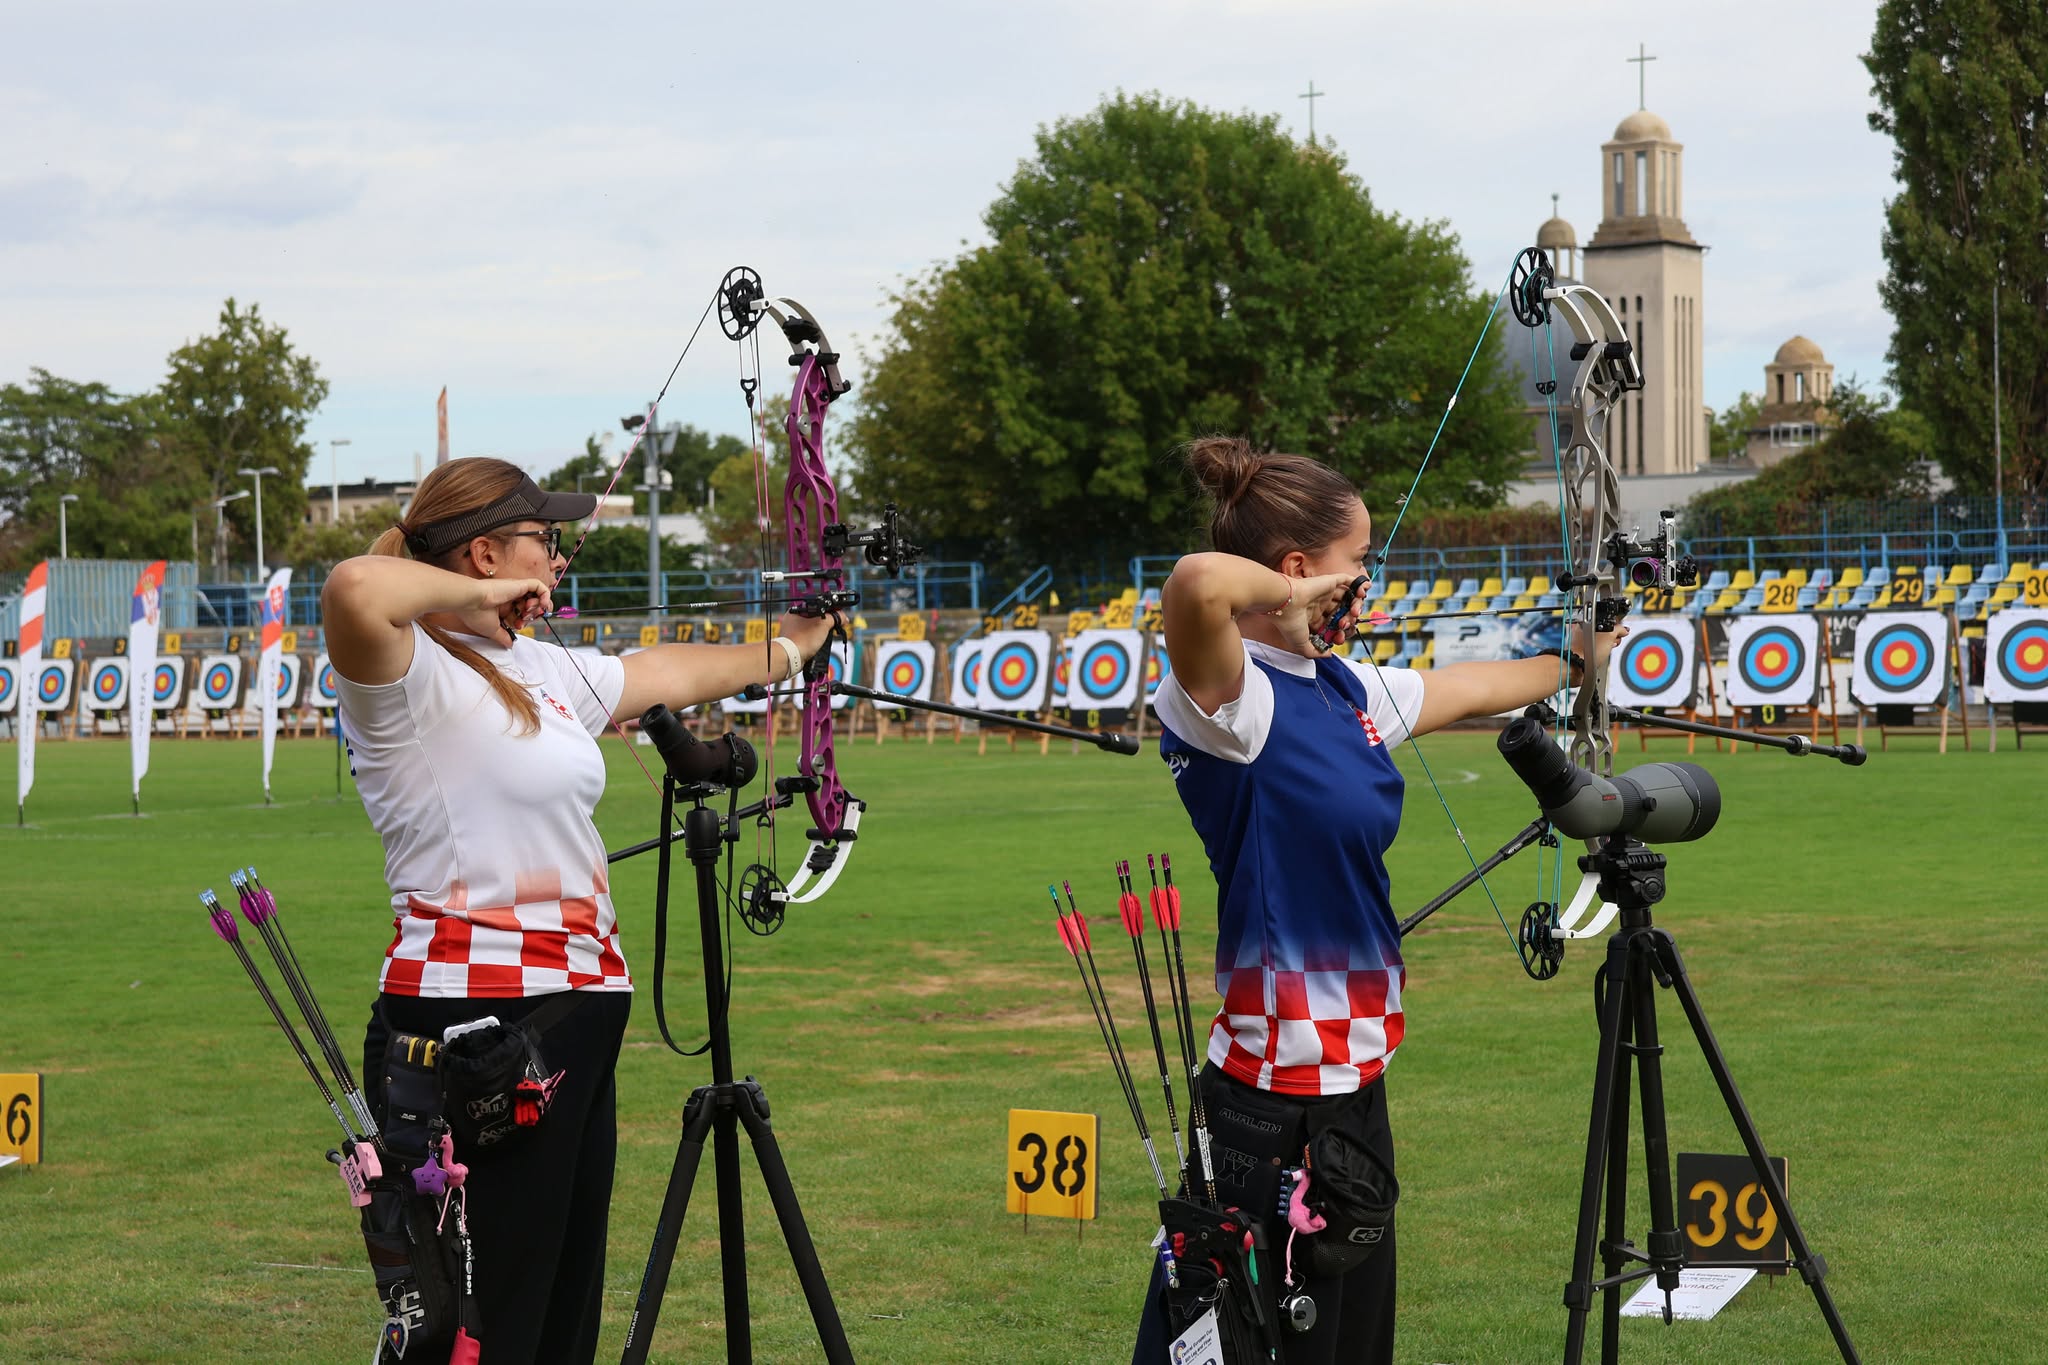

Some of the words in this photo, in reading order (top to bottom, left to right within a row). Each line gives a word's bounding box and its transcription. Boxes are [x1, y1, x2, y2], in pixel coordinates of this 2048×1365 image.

[1644, 587, 1668, 610] 27
[1767, 584, 1796, 606] 28
[1892, 579, 1923, 603] 29
[1014, 604, 1040, 628] 25
[1109, 604, 1133, 623] 26
[582, 626, 595, 642] 11
[114, 639, 126, 655] 3
[1762, 703, 1775, 724] 0
[0, 1093, 32, 1146] 6
[1219, 1107, 1282, 1134] AVALON
[1014, 1133, 1087, 1197] 38
[1686, 1180, 1778, 1250] 39
